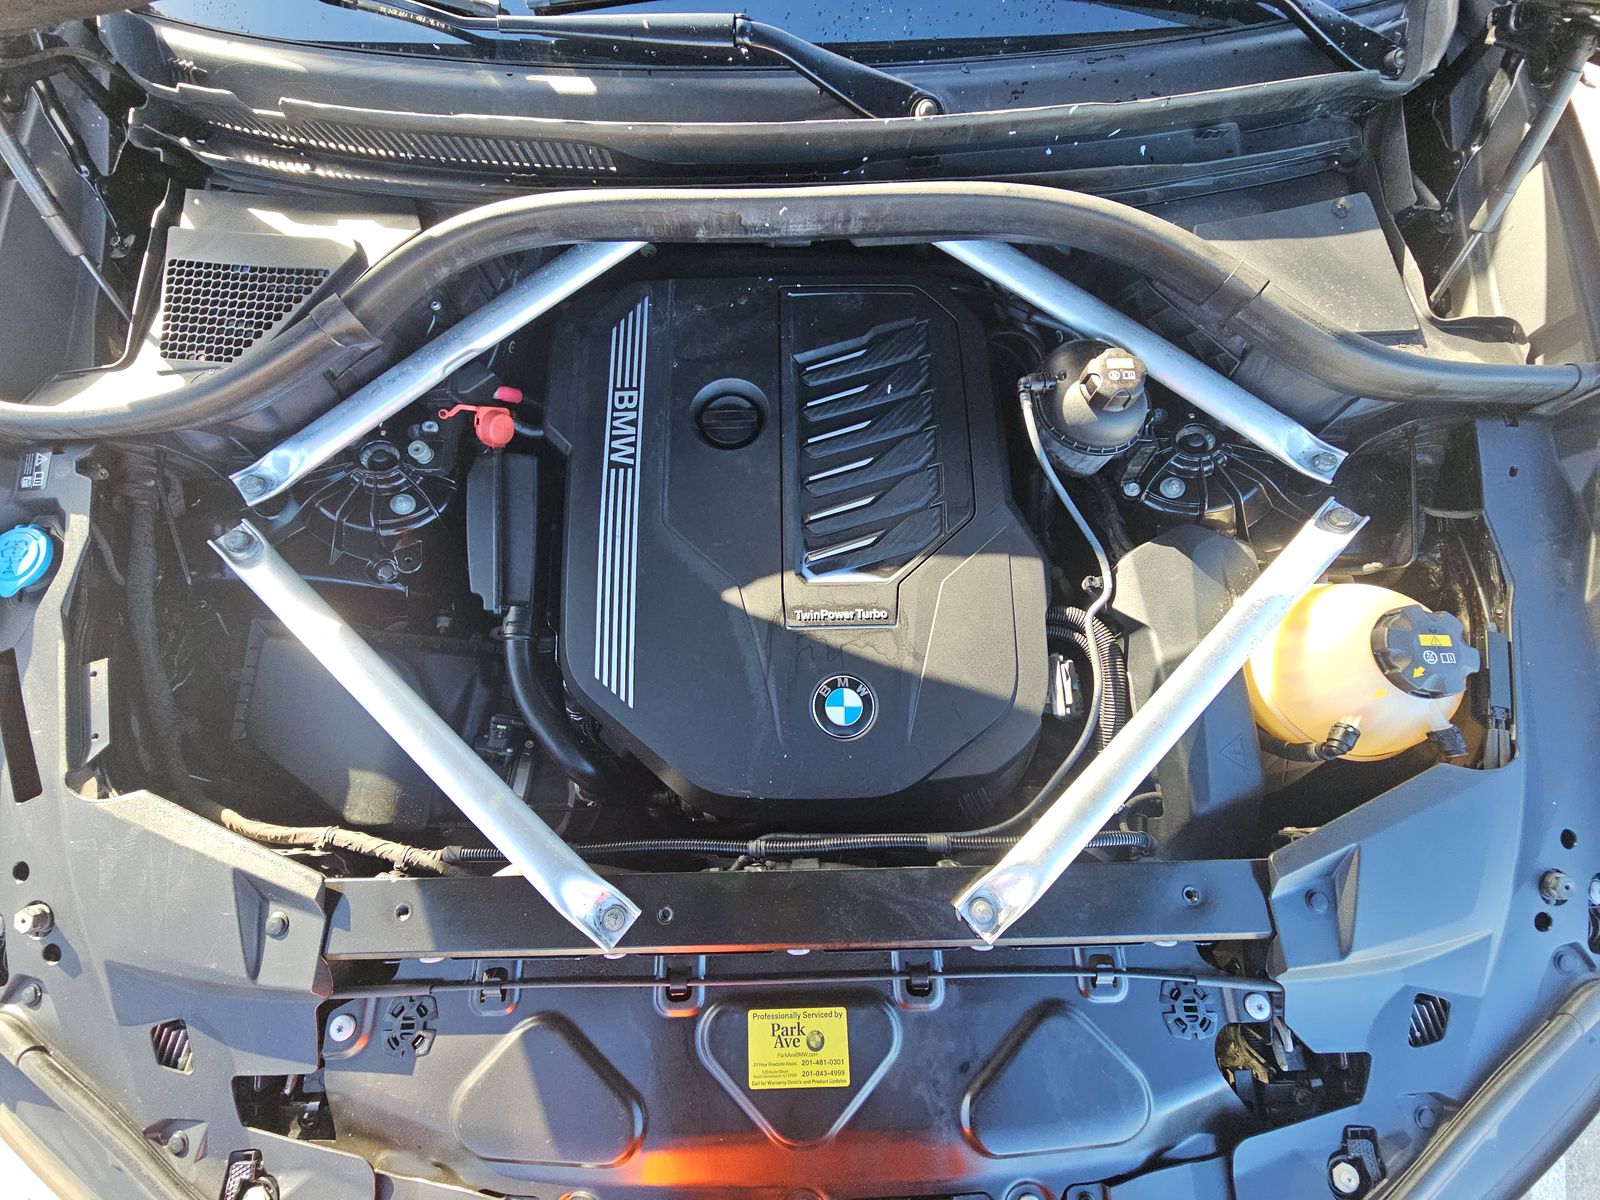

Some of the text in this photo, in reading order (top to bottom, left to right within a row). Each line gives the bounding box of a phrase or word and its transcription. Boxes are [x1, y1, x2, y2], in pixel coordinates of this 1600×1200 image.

[610, 390, 639, 465] BMW
[793, 608, 888, 620] TwinPower Turbo
[819, 677, 869, 697] BMW
[752, 1010, 843, 1020] Professionally Serviced by
[770, 1022, 806, 1037] Park
[773, 1035, 801, 1048] Ave
[802, 1069, 845, 1077] 201-843-4999
